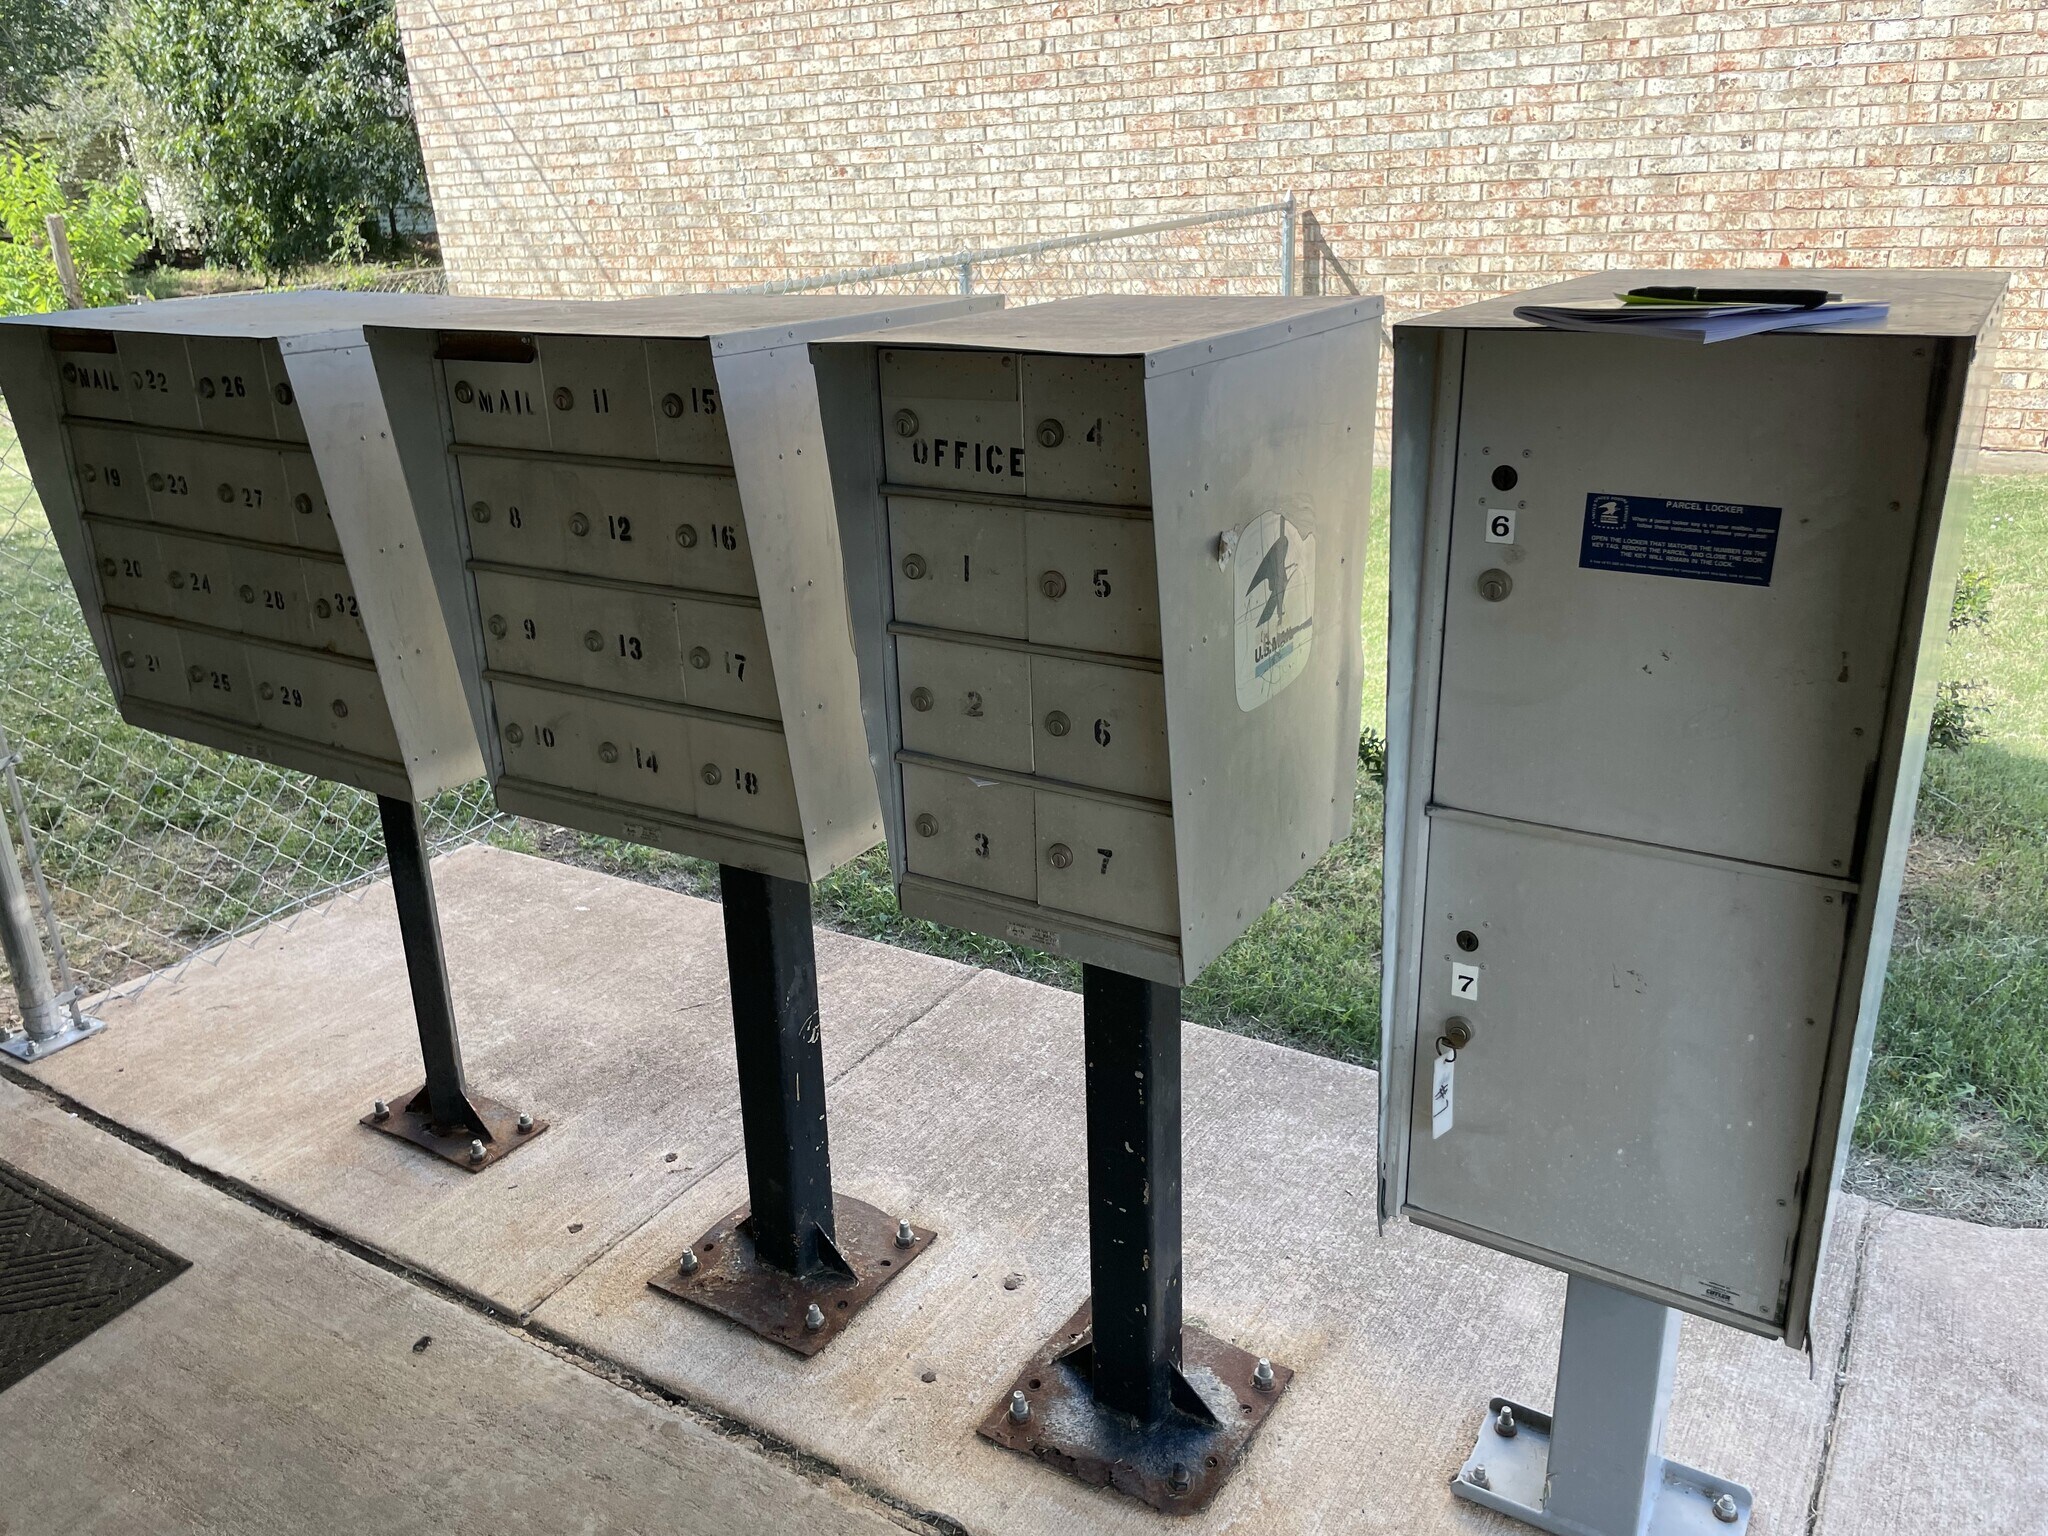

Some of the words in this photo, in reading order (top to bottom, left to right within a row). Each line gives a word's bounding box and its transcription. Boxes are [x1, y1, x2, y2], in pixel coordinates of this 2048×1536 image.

[78, 367, 120, 392] MAIL
[145, 368, 169, 393] 22
[221, 375, 247, 399] 26
[477, 388, 536, 416] MAIL
[592, 387, 609, 414] 11
[691, 387, 718, 415] 15
[1086, 417, 1103, 449] 4
[912, 438, 1026, 478] OFFICE
[104, 465, 121, 487] 19
[167, 473, 189, 496] 23
[241, 487, 263, 508] 27
[1665, 500, 1702, 511] PARCEL
[1705, 504, 1744, 514] LOCKER
[508, 505, 522, 529] 8
[607, 515, 632, 542] 12
[1491, 515, 1510, 537] 6
[710, 523, 737, 551] 16
[963, 554, 970, 583] 1
[190, 572, 212, 595] 24
[1092, 568, 1112, 598] 5
[262, 589, 286, 610] 28
[334, 592, 359, 618] 32
[523, 617, 537, 640] 9
[618, 633, 643, 661] 13
[724, 651, 747, 682] 17
[210, 671, 232, 692] 25
[963, 690, 984, 718] 2
[534, 724, 556, 748] 10
[1094, 718, 1111, 748] 6
[635, 747, 659, 774] 14
[734, 768, 759, 795] 18
[974, 832, 990, 858] 3
[1097, 847, 1113, 875] 7
[1457, 974, 1475, 993] 7
